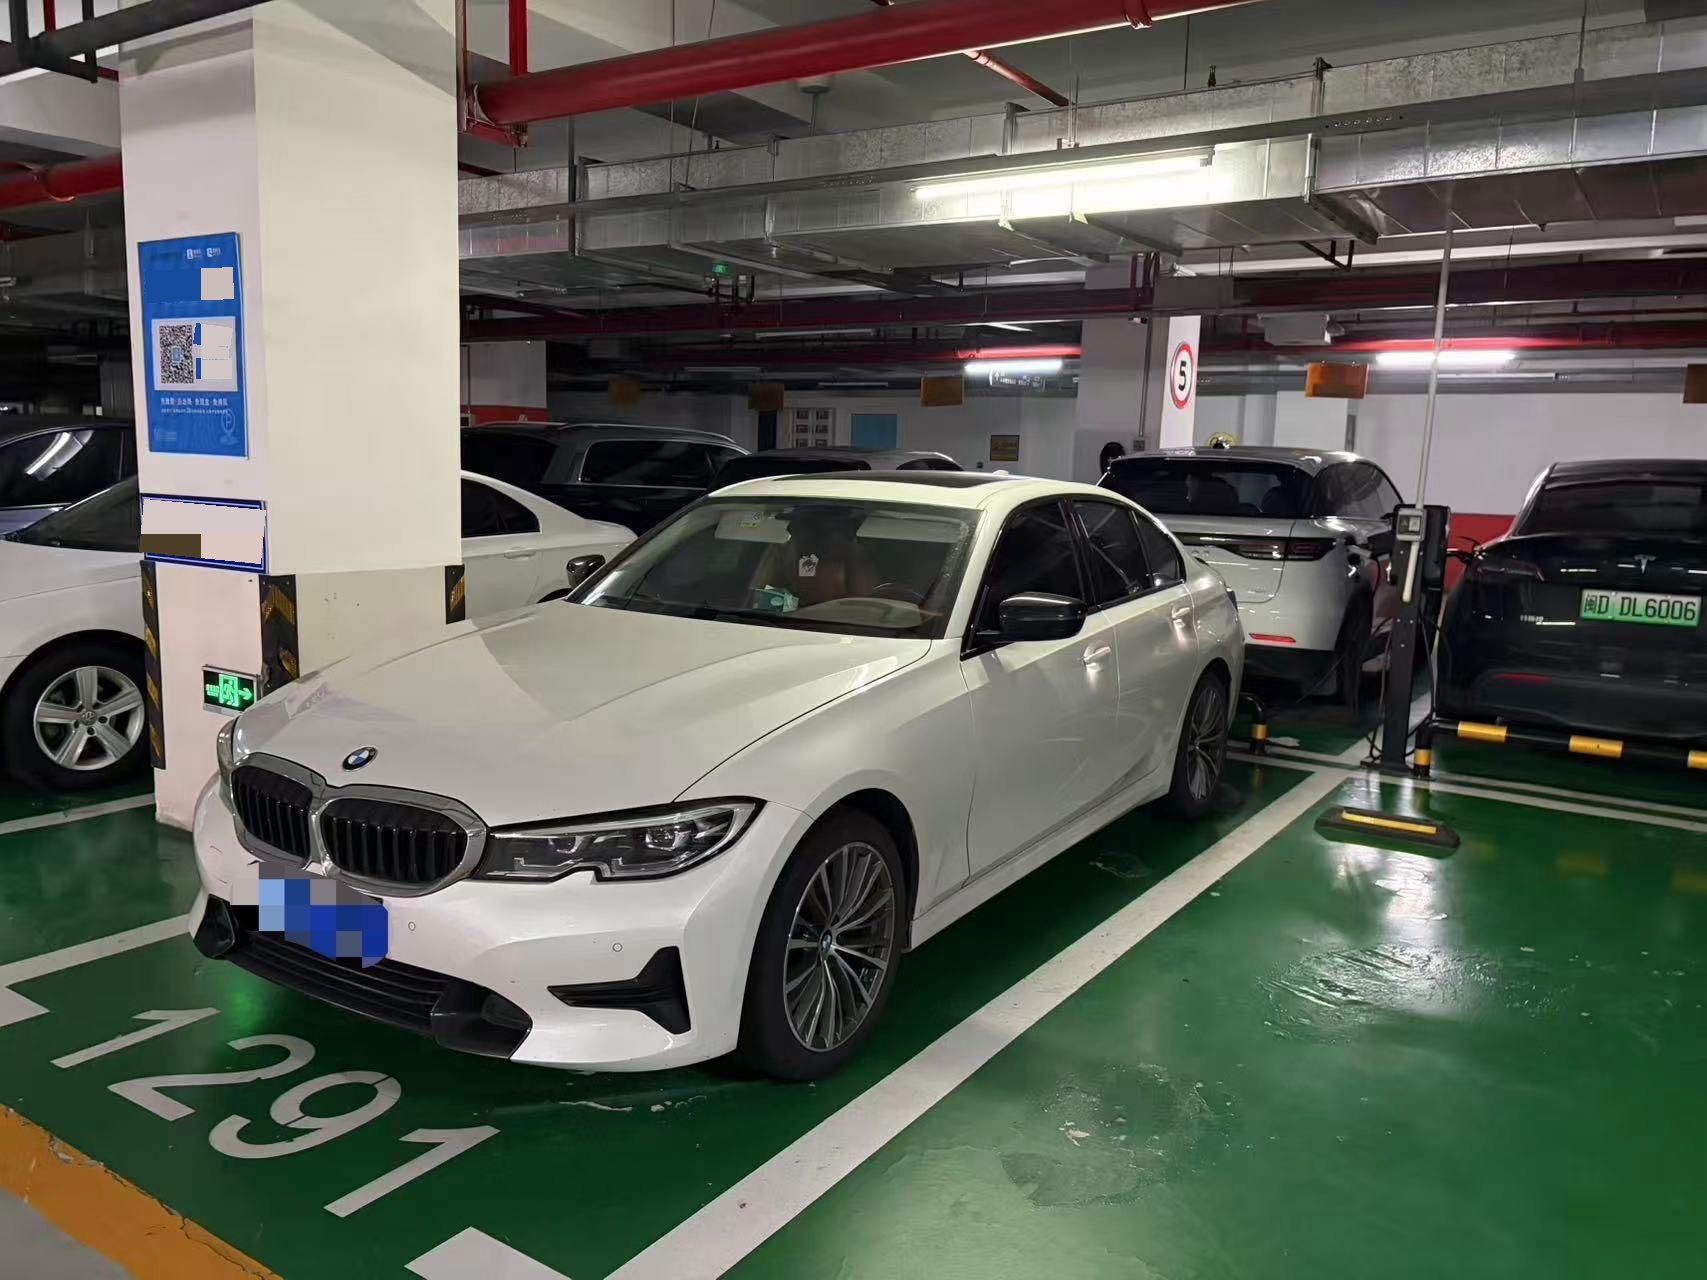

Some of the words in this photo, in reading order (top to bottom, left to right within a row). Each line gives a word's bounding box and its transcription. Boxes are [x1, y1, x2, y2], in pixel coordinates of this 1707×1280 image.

[1178, 360, 1187, 391] 5
[1619, 596, 1697, 620] DL6006
[50, 1007, 500, 1218] 1291
